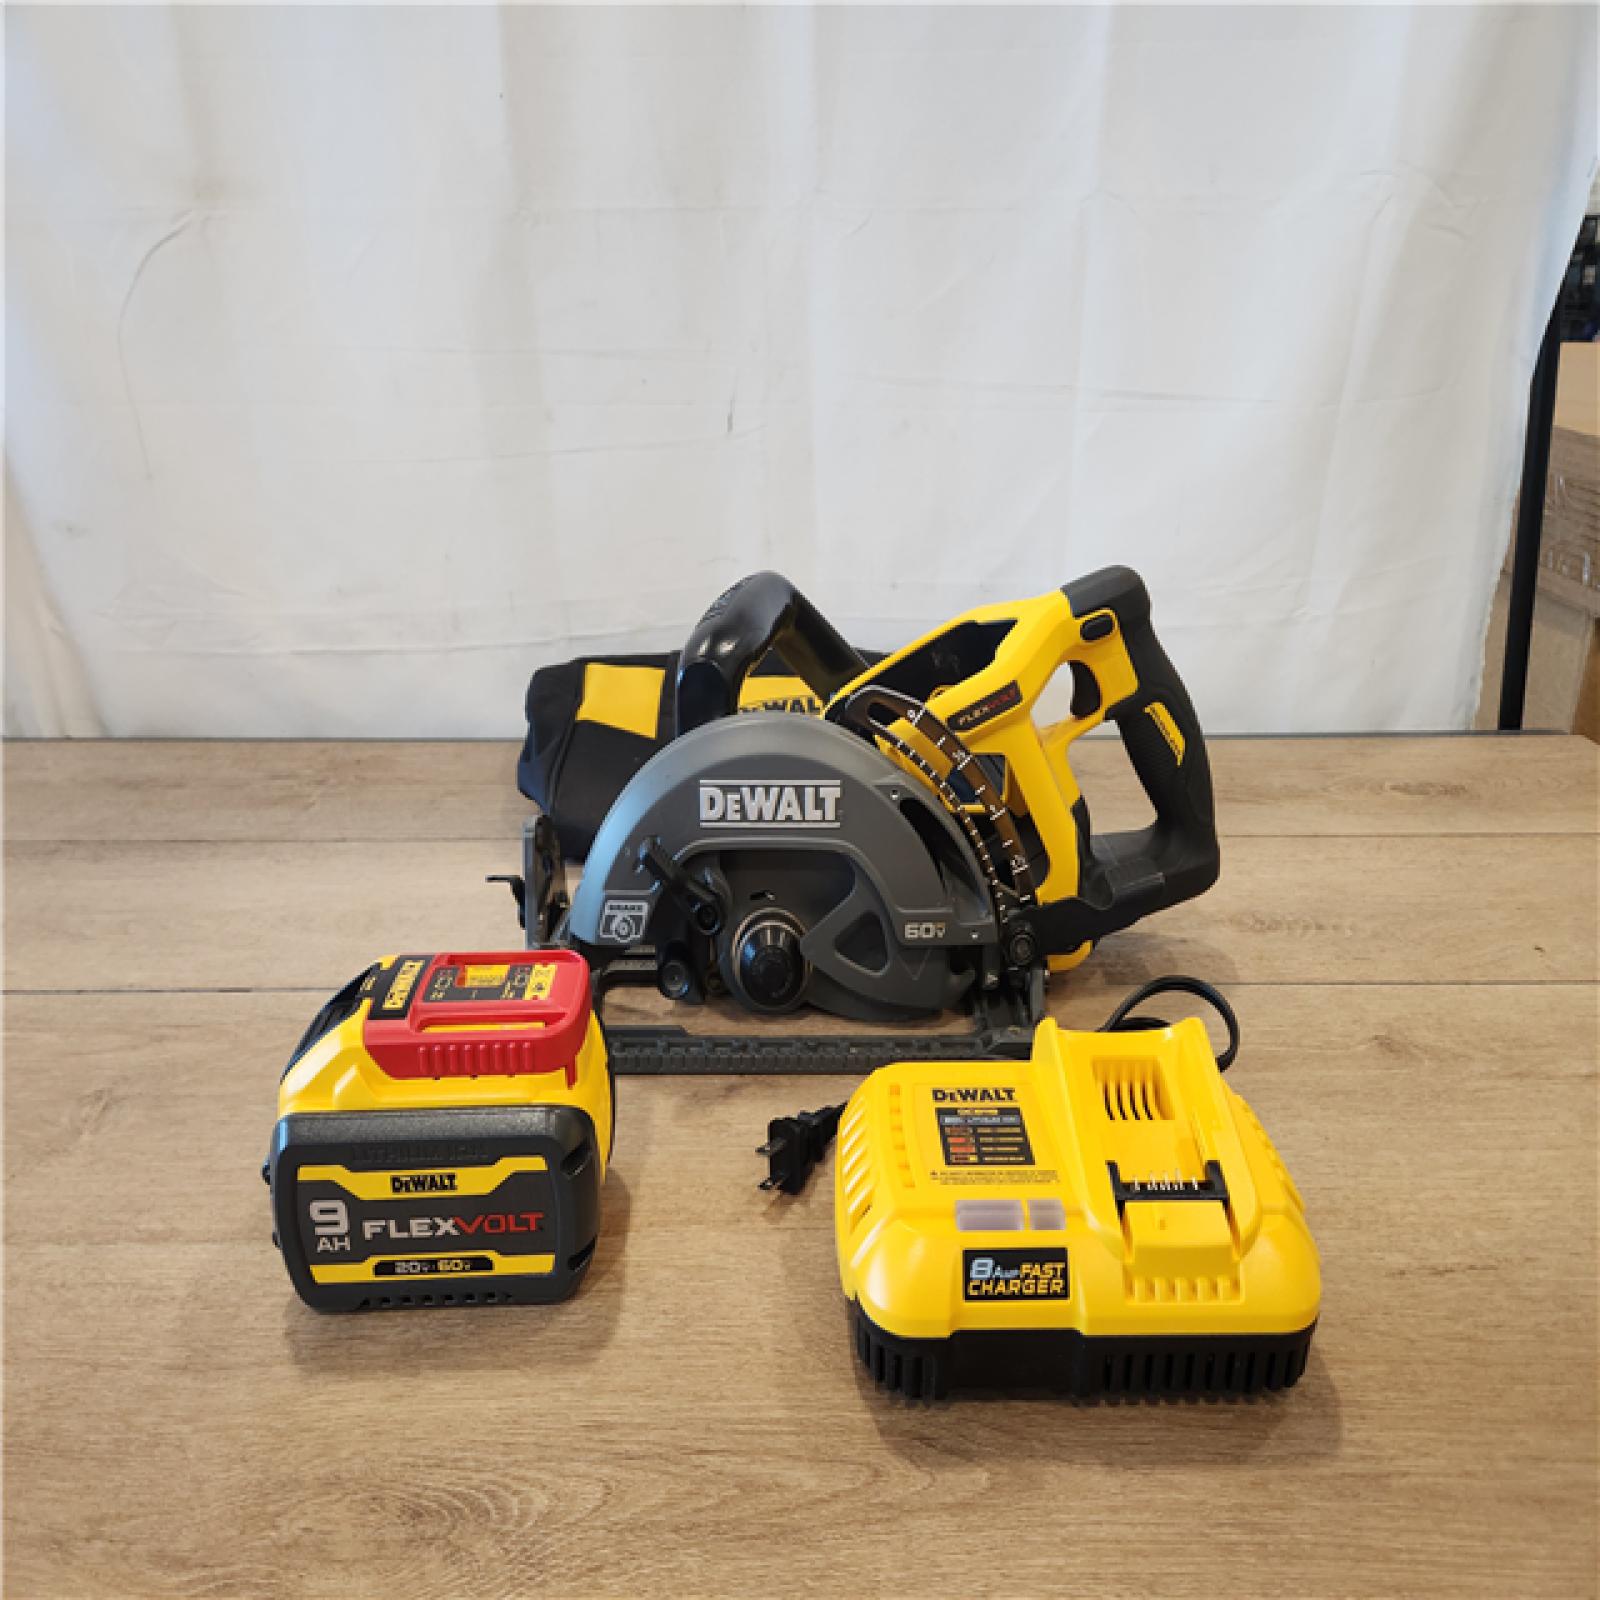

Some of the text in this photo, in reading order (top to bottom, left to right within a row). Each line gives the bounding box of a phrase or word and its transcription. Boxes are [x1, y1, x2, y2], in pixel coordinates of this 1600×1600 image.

[699, 786, 841, 821] DEWALT
[931, 1088, 1016, 1103] DEWALT
[390, 1174, 458, 1193] DEWALT
[309, 1200, 349, 1236] 9
[362, 1212, 545, 1241] FLEXVOLT
[316, 1236, 351, 1253] AH
[1020, 1261, 1066, 1279] FAST
[967, 1279, 1066, 1296] CHARGER
